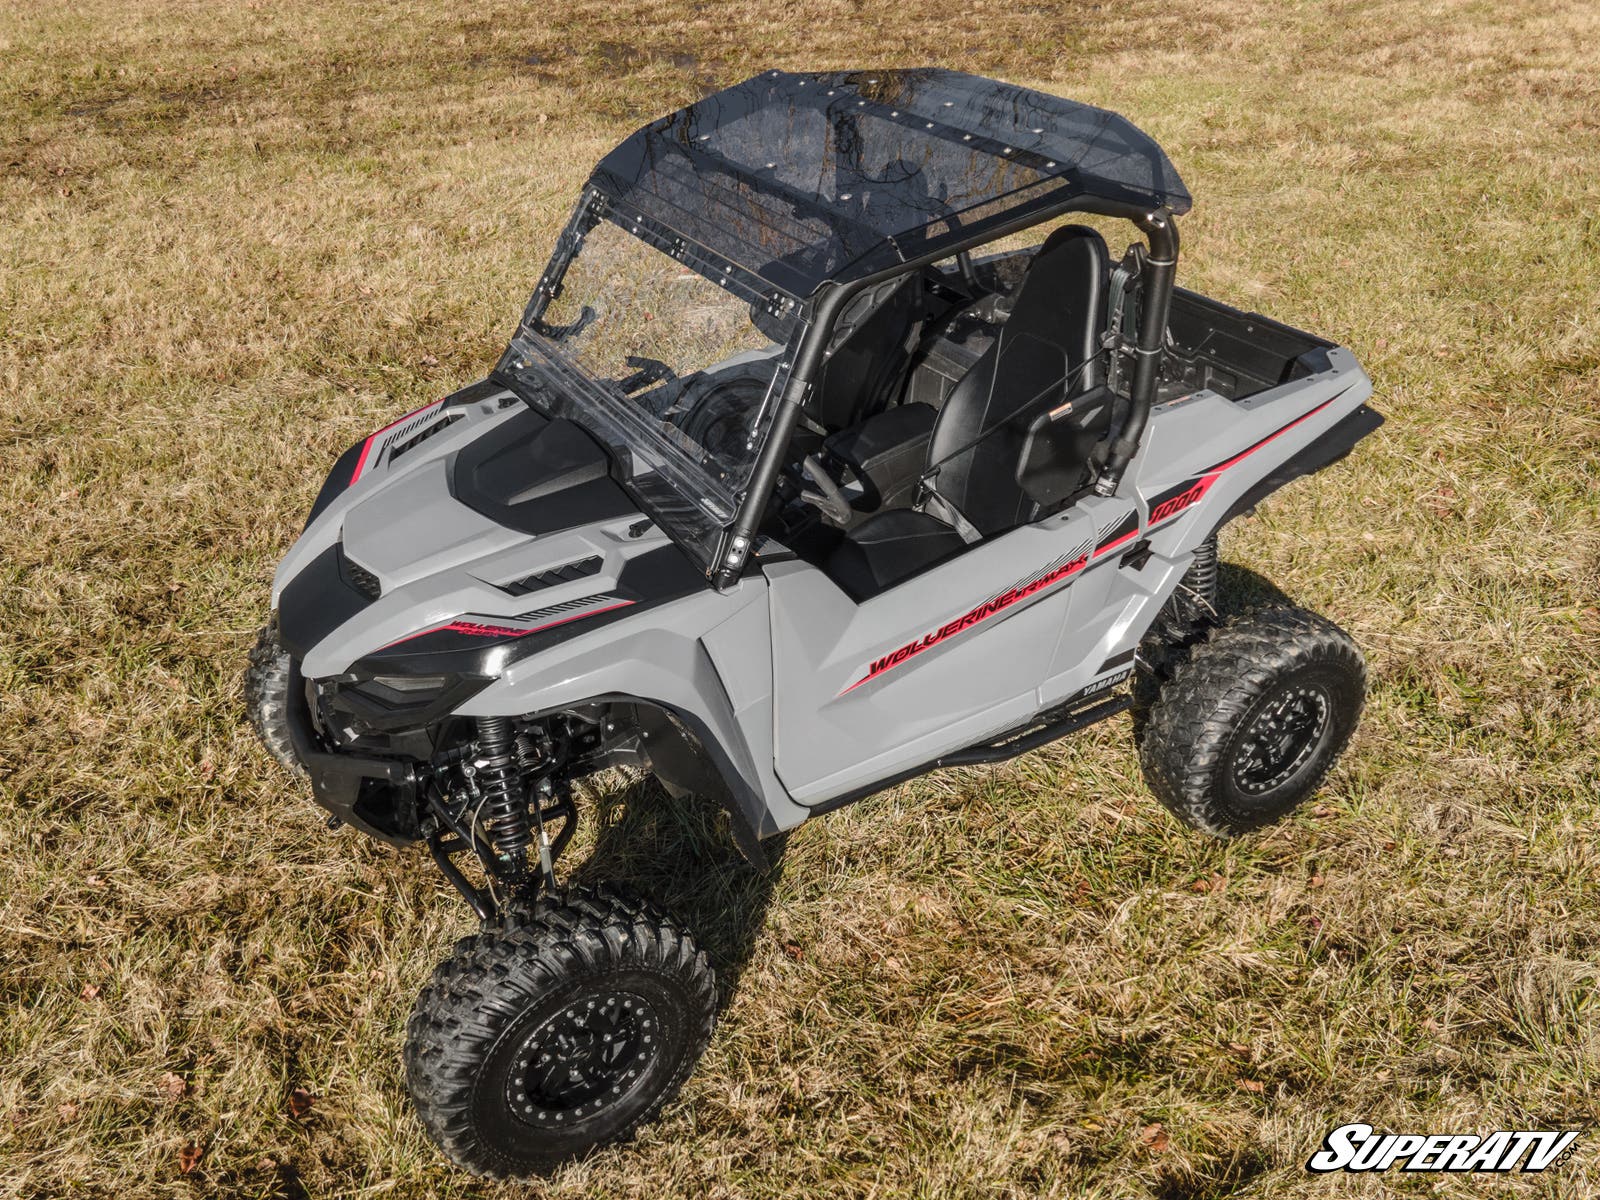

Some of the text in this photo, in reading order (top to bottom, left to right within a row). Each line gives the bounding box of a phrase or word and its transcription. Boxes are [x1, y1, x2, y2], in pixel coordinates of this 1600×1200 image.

[1149, 486, 1204, 524] 1000
[868, 588, 1017, 676] WOLVERINE
[1083, 671, 1128, 696] YAMAHA
